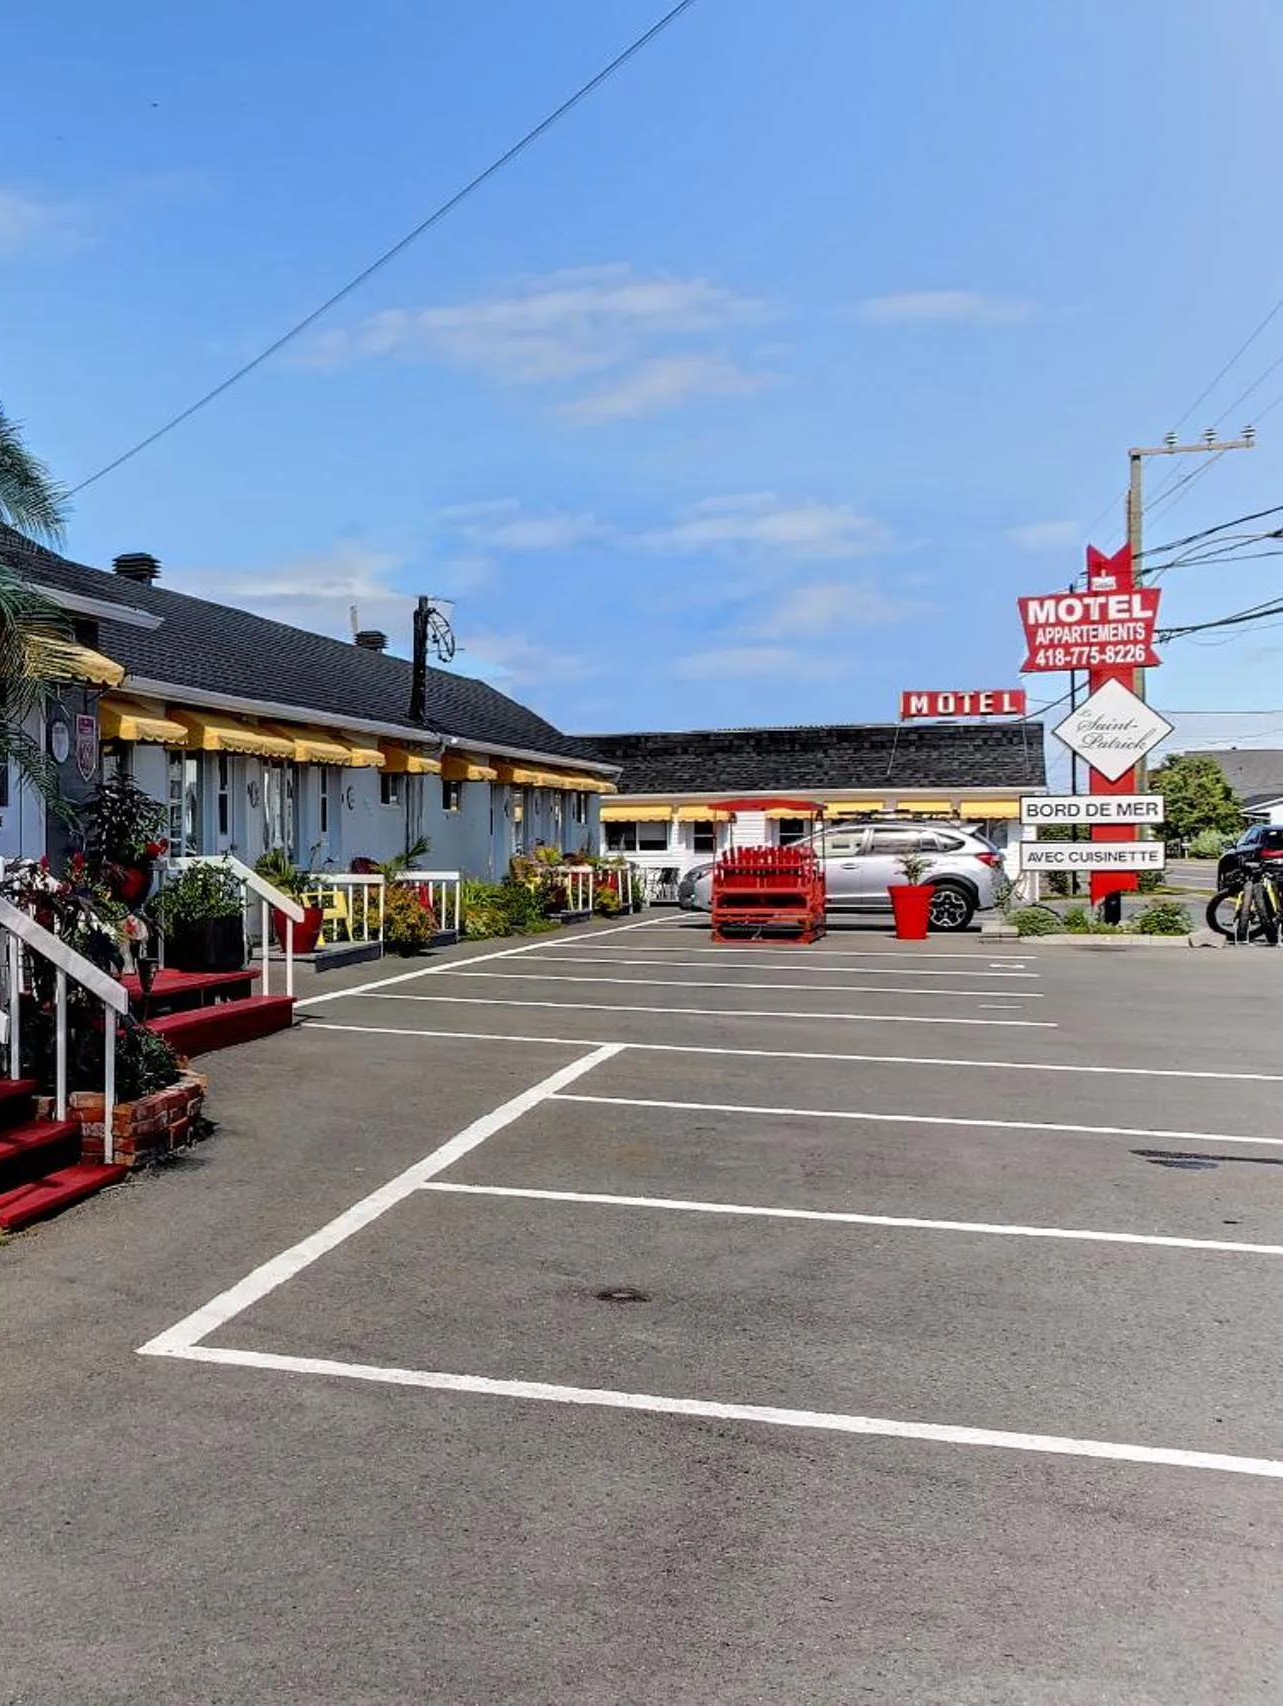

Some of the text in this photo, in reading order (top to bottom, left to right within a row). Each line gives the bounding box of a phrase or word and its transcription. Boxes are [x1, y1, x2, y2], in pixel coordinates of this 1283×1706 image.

[1027, 594, 1154, 625] MOTEL
[1035, 622, 1146, 646] APPARTEMENTS
[1035, 644, 1146, 667] 418-775-8226
[910, 692, 1018, 715] MOTEL
[1077, 728, 1157, 751] Patrick
[1026, 802, 1159, 817] BORD DE MER
[1027, 850, 1159, 863] AVEC CUISINETTE
